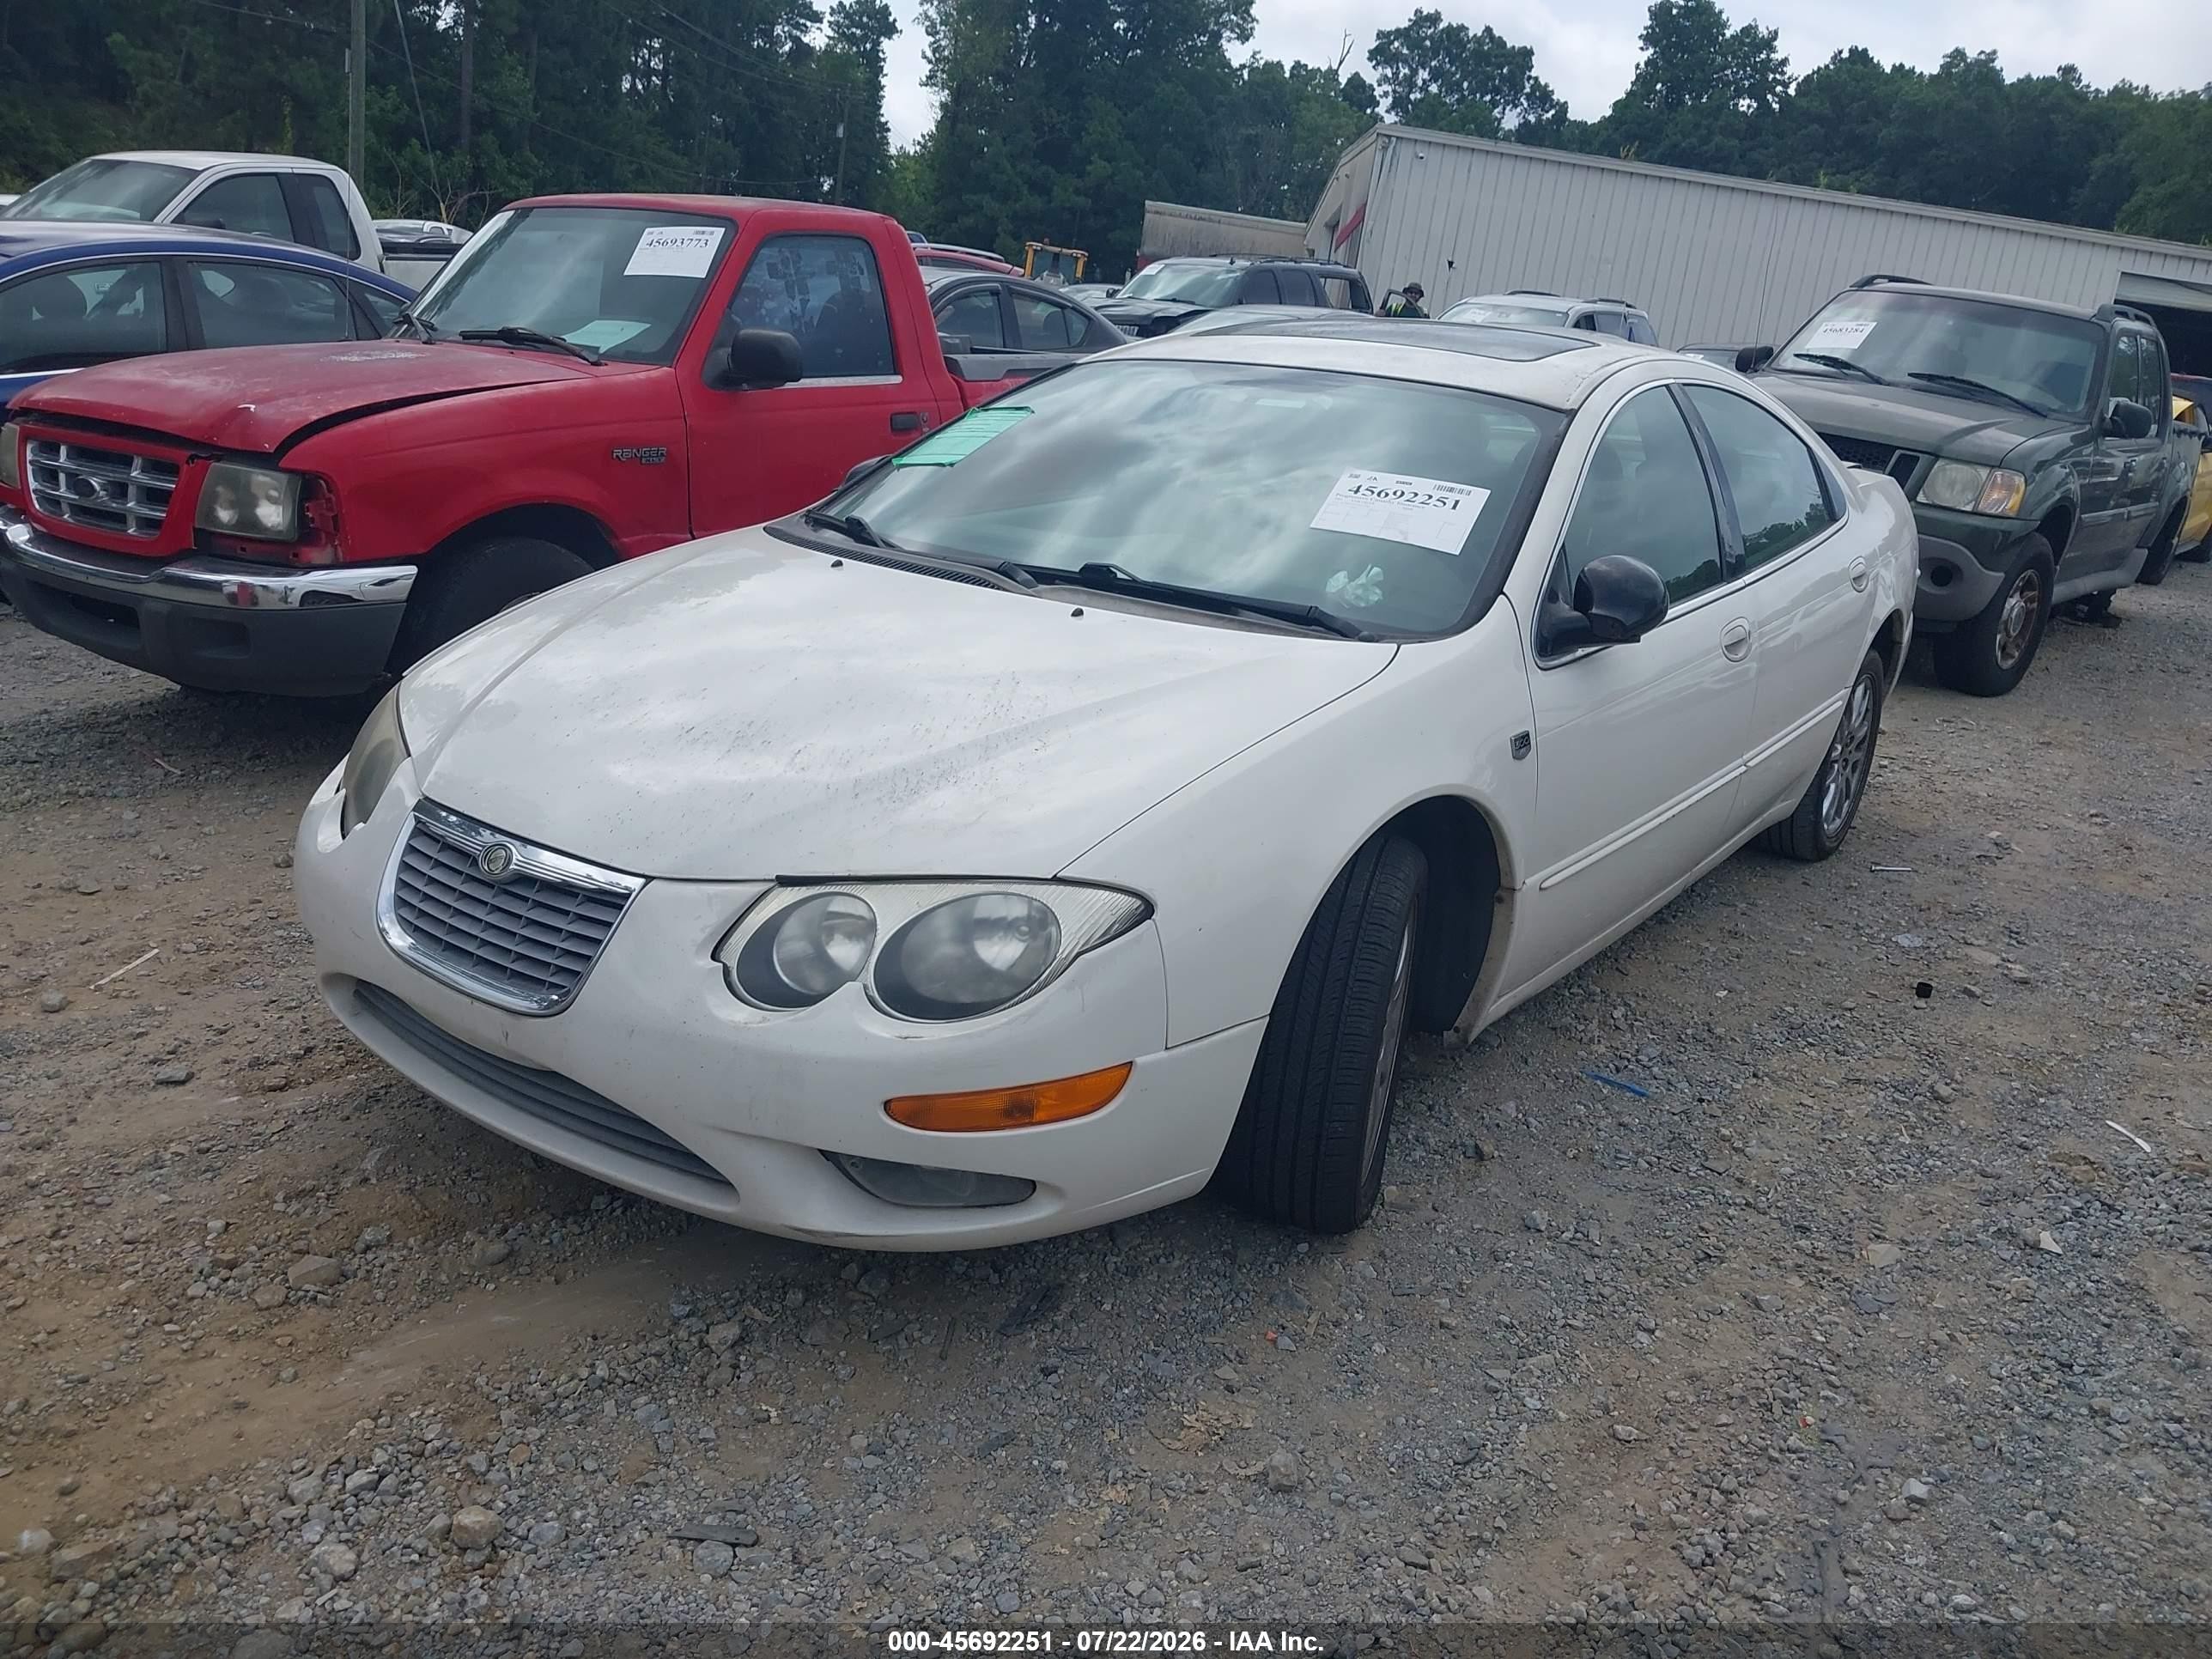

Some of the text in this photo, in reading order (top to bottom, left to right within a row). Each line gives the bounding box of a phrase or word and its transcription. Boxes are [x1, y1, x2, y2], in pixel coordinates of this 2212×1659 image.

[646, 238, 709, 248] 45693773
[613, 447, 667, 461] RANGER
[1347, 483, 1462, 511] 45692251
